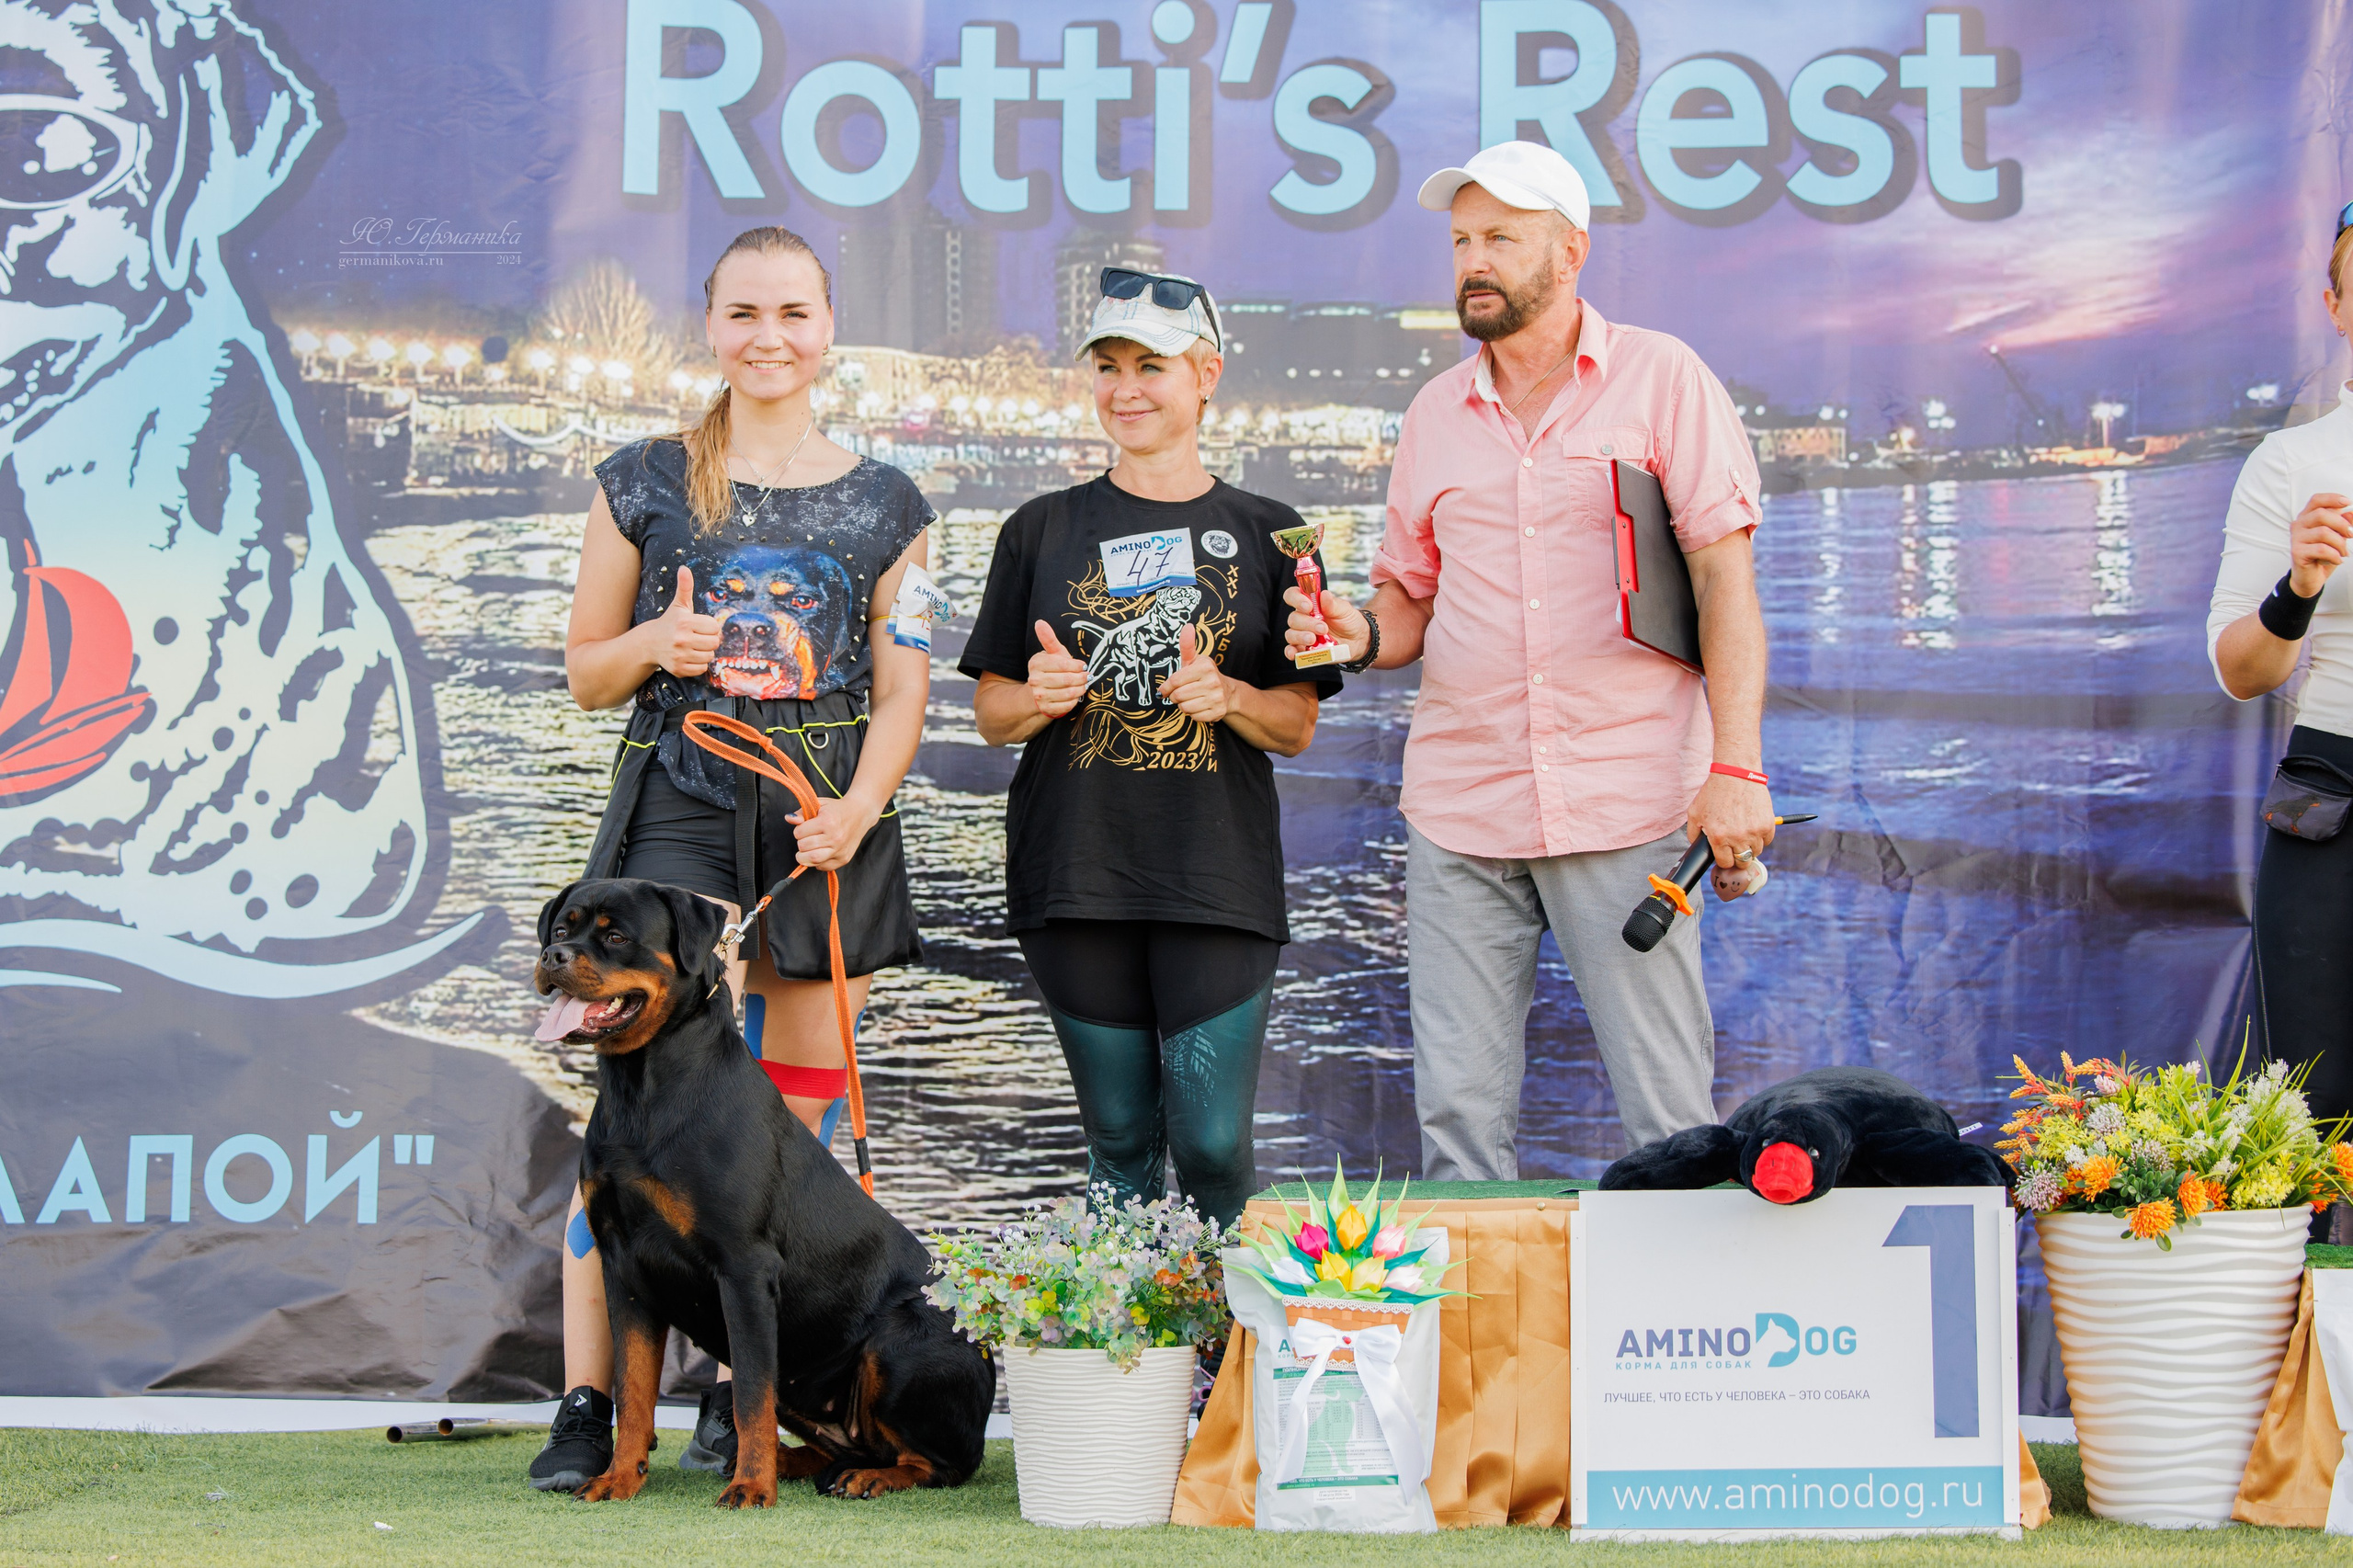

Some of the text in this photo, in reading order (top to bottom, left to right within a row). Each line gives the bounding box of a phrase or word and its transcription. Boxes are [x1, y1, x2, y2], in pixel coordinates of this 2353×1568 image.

[622, 0, 1999, 215] Rotti's Rest
[1127, 546, 1174, 586] 47
[1214, 609, 1238, 666] КУБО
[1146, 751, 1199, 770] 2023
[1881, 1204, 1980, 1439] 1
[1615, 1360, 1753, 1370] КОРМА ДЛЯ СОБАК
[1604, 1392, 1655, 1403] ЛУЧШЕЕ,
[1659, 1392, 1682, 1402] ЧТО
[1685, 1392, 1713, 1402] ЕСТЬ
[1715, 1392, 1723, 1402] У
[1725, 1391, 1787, 1402] ЧЕЛОВЕКА
[1798, 1390, 1822, 1401] ЭТО
[1824, 1389, 1870, 1400] СОБАКА
[1612, 1473, 1984, 1519] www.aminodog.ru
